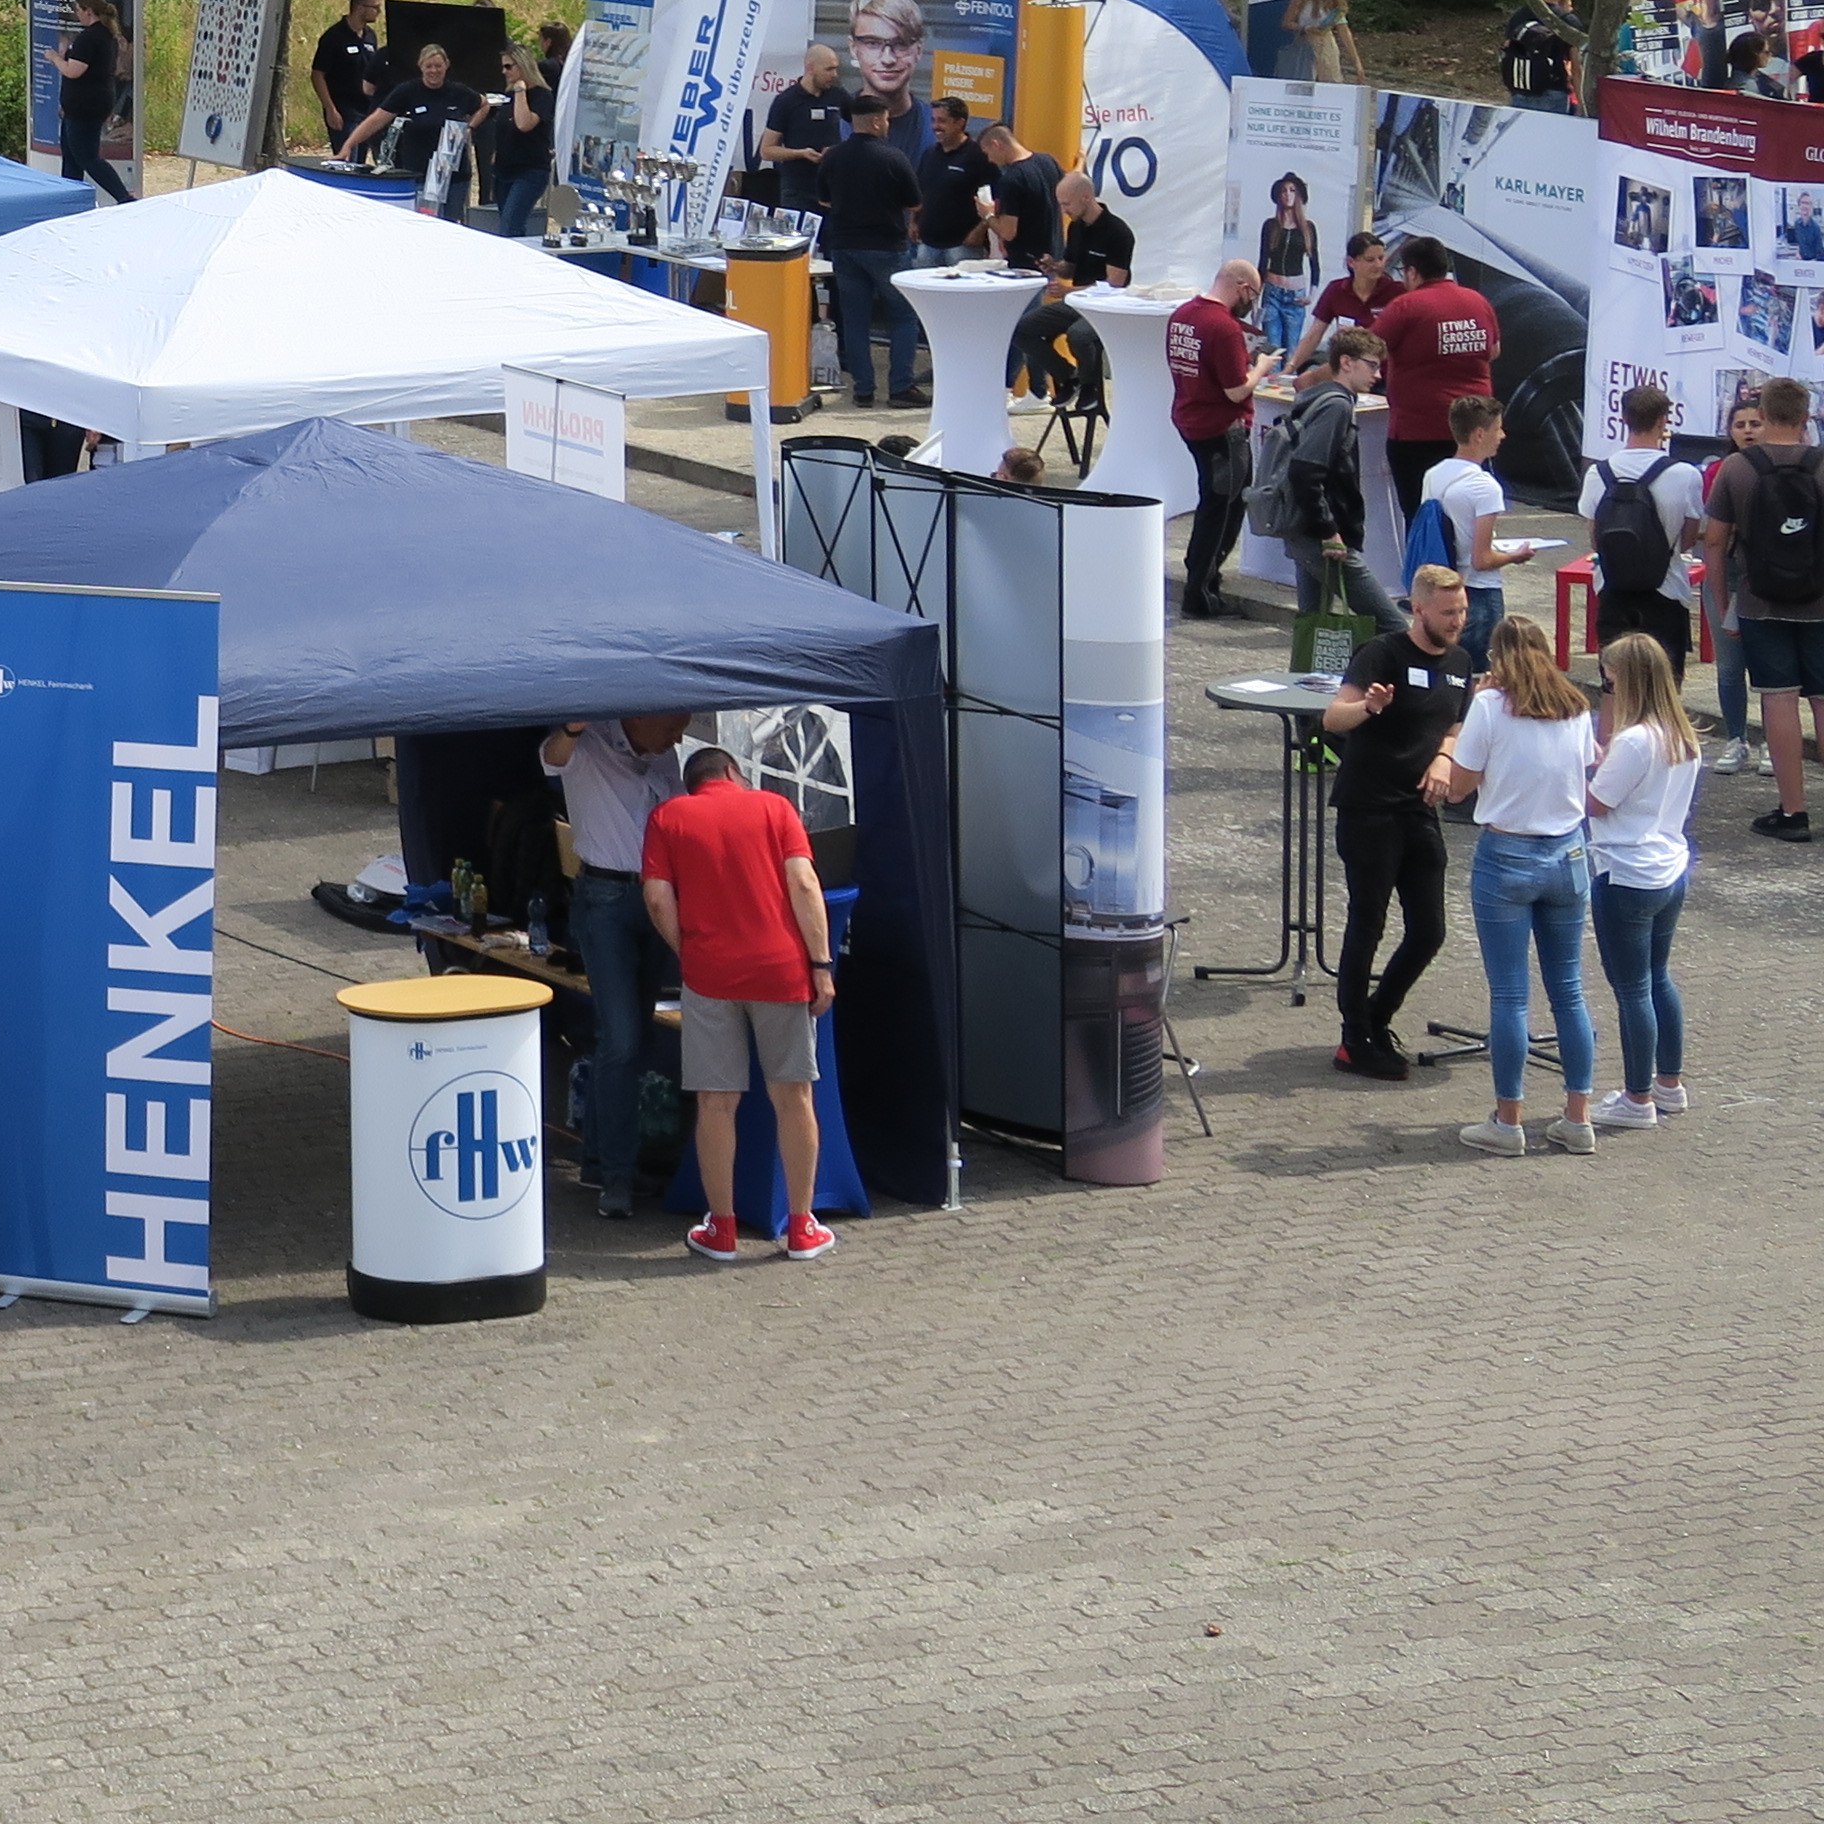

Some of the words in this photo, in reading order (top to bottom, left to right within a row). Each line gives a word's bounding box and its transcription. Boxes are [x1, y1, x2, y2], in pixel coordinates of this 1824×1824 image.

[970, 0, 1014, 19] FEINTOOL
[944, 63, 984, 78] PRÄZISION
[762, 70, 784, 93] Sie
[943, 78, 974, 89] UNSERE
[720, 101, 734, 134] die
[1085, 105, 1112, 124] Sie
[1116, 104, 1155, 123] nah.
[1248, 106, 1272, 118] OHNE
[1273, 107, 1295, 119] DICH
[1329, 111, 1342, 122] ES
[1247, 122, 1264, 133] NUR
[1289, 125, 1311, 137] KEIN
[1312, 127, 1341, 138] STYLE
[1645, 116, 1688, 141] Wilhelm
[1689, 122, 1756, 154] Brandenburg
[1495, 176, 1532, 196] KARL
[1535, 184, 1585, 203] MAYER
[1442, 318, 1477, 332] ETWAS
[1442, 329, 1487, 344] GROSSES
[1441, 341, 1487, 355] STARTEN
[1610, 360, 1669, 394] ETWAS
[17, 679, 47, 688] HENKEL
[106, 695, 220, 1290] HENKEL
[422, 1089, 537, 1203] fHw
